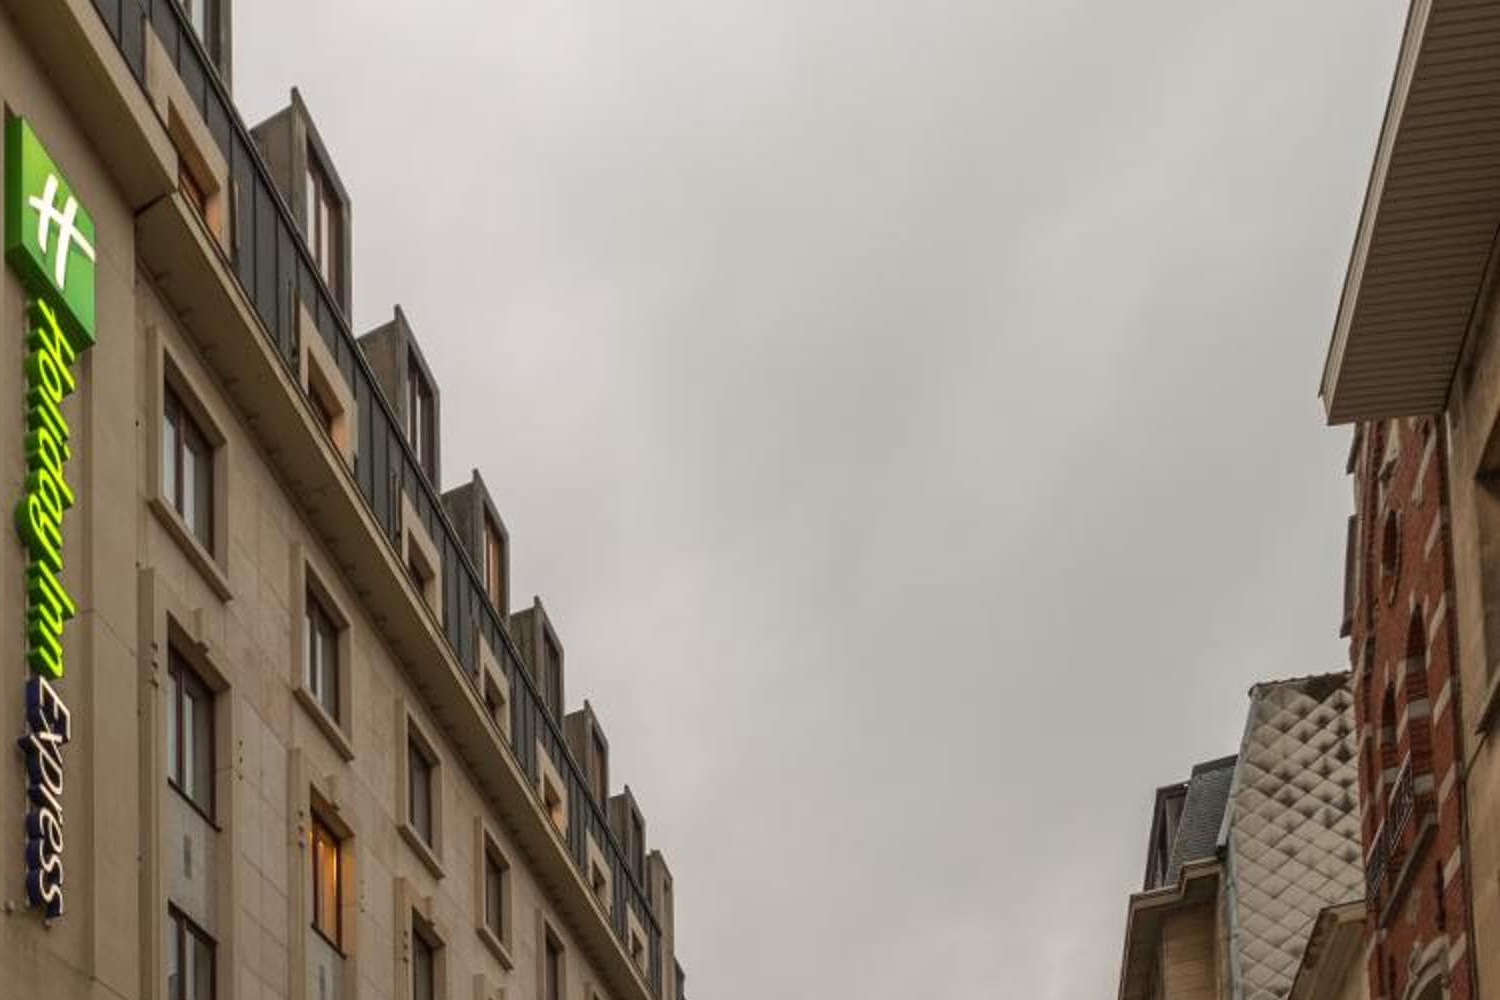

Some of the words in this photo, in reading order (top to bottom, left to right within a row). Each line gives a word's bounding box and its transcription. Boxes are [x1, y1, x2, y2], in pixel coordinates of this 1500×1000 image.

[29, 297, 77, 570] Holiday
[38, 558, 77, 678] Inn
[30, 675, 71, 915] Express
